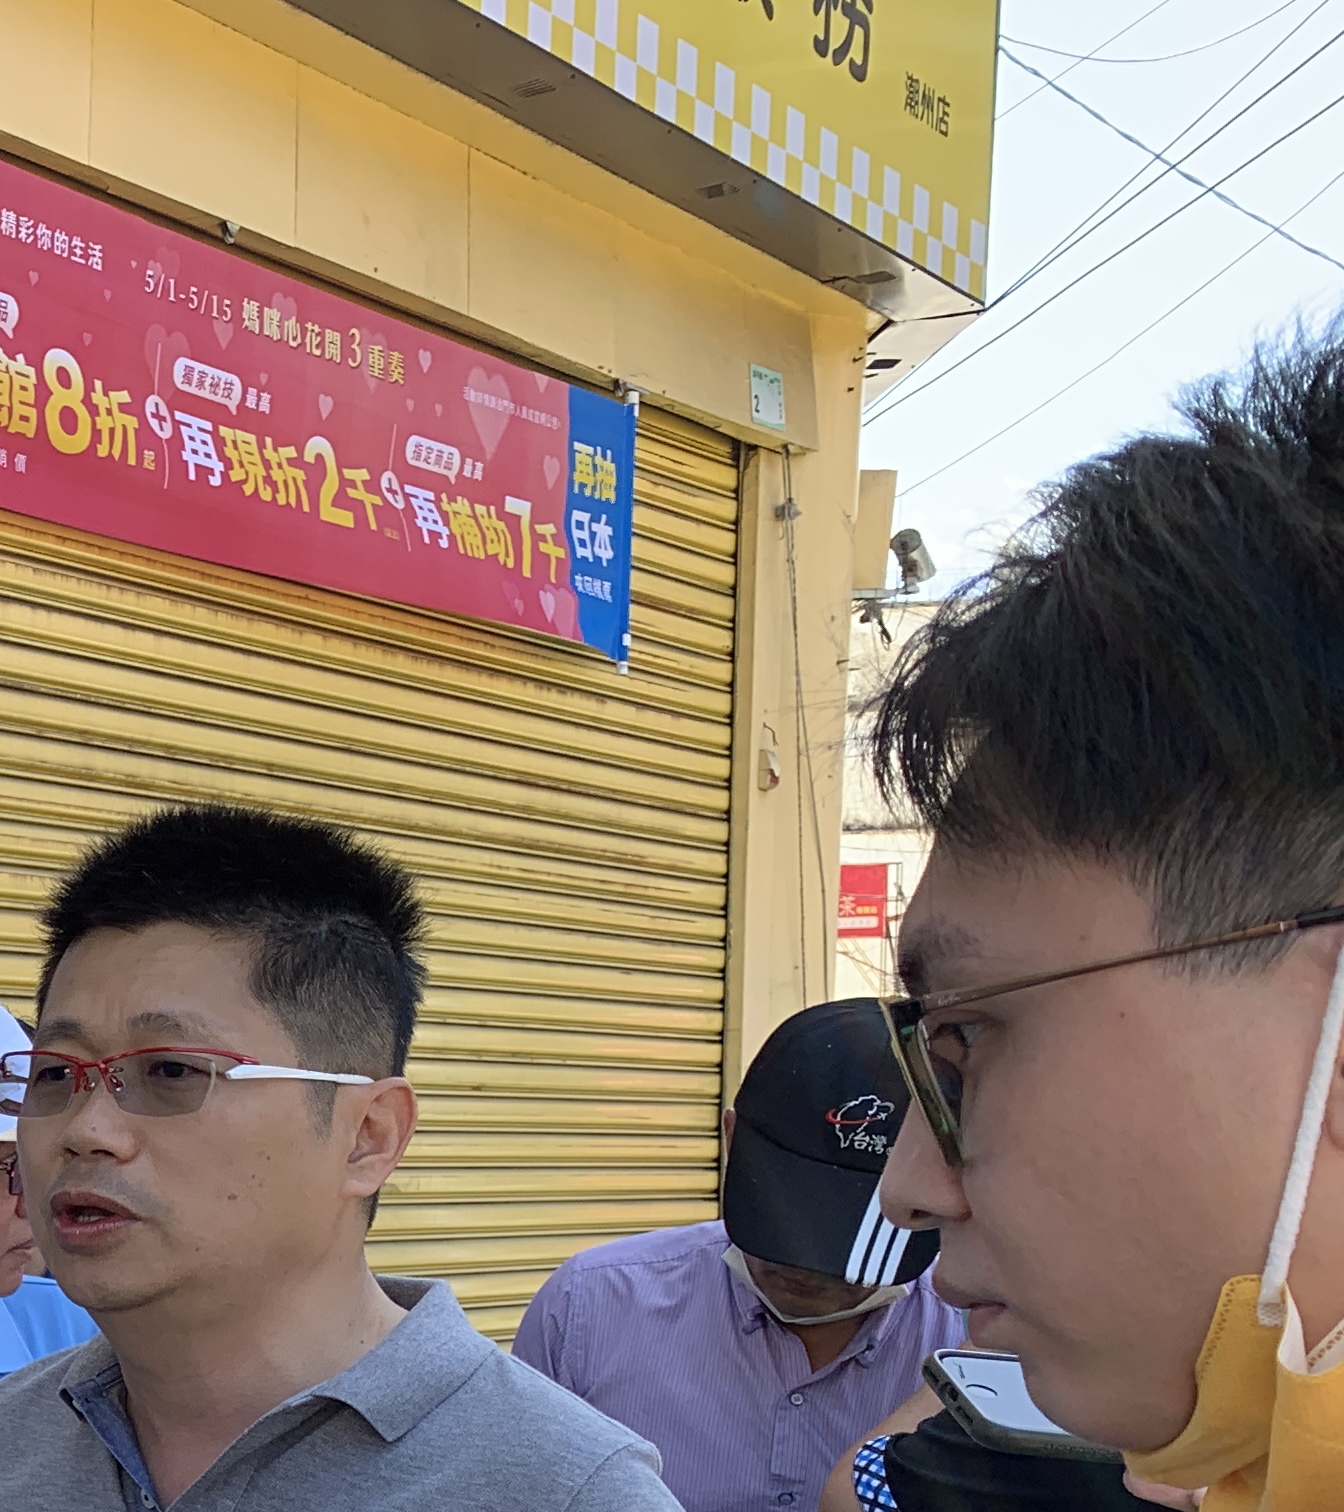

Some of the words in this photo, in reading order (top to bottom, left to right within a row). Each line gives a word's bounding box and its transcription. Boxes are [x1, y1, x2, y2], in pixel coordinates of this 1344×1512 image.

[904, 71, 951, 138] 潮州店
[0, 208, 103, 271] 精彩你的生活
[144, 270, 231, 321] 5/1-5/15
[174, 410, 384, 531] 再現折2千
[412, 441, 454, 472] 指定商品
[404, 484, 566, 583] 再補助7千
[571, 509, 614, 567] 日本
[854, 1133, 894, 1156] 台灣
